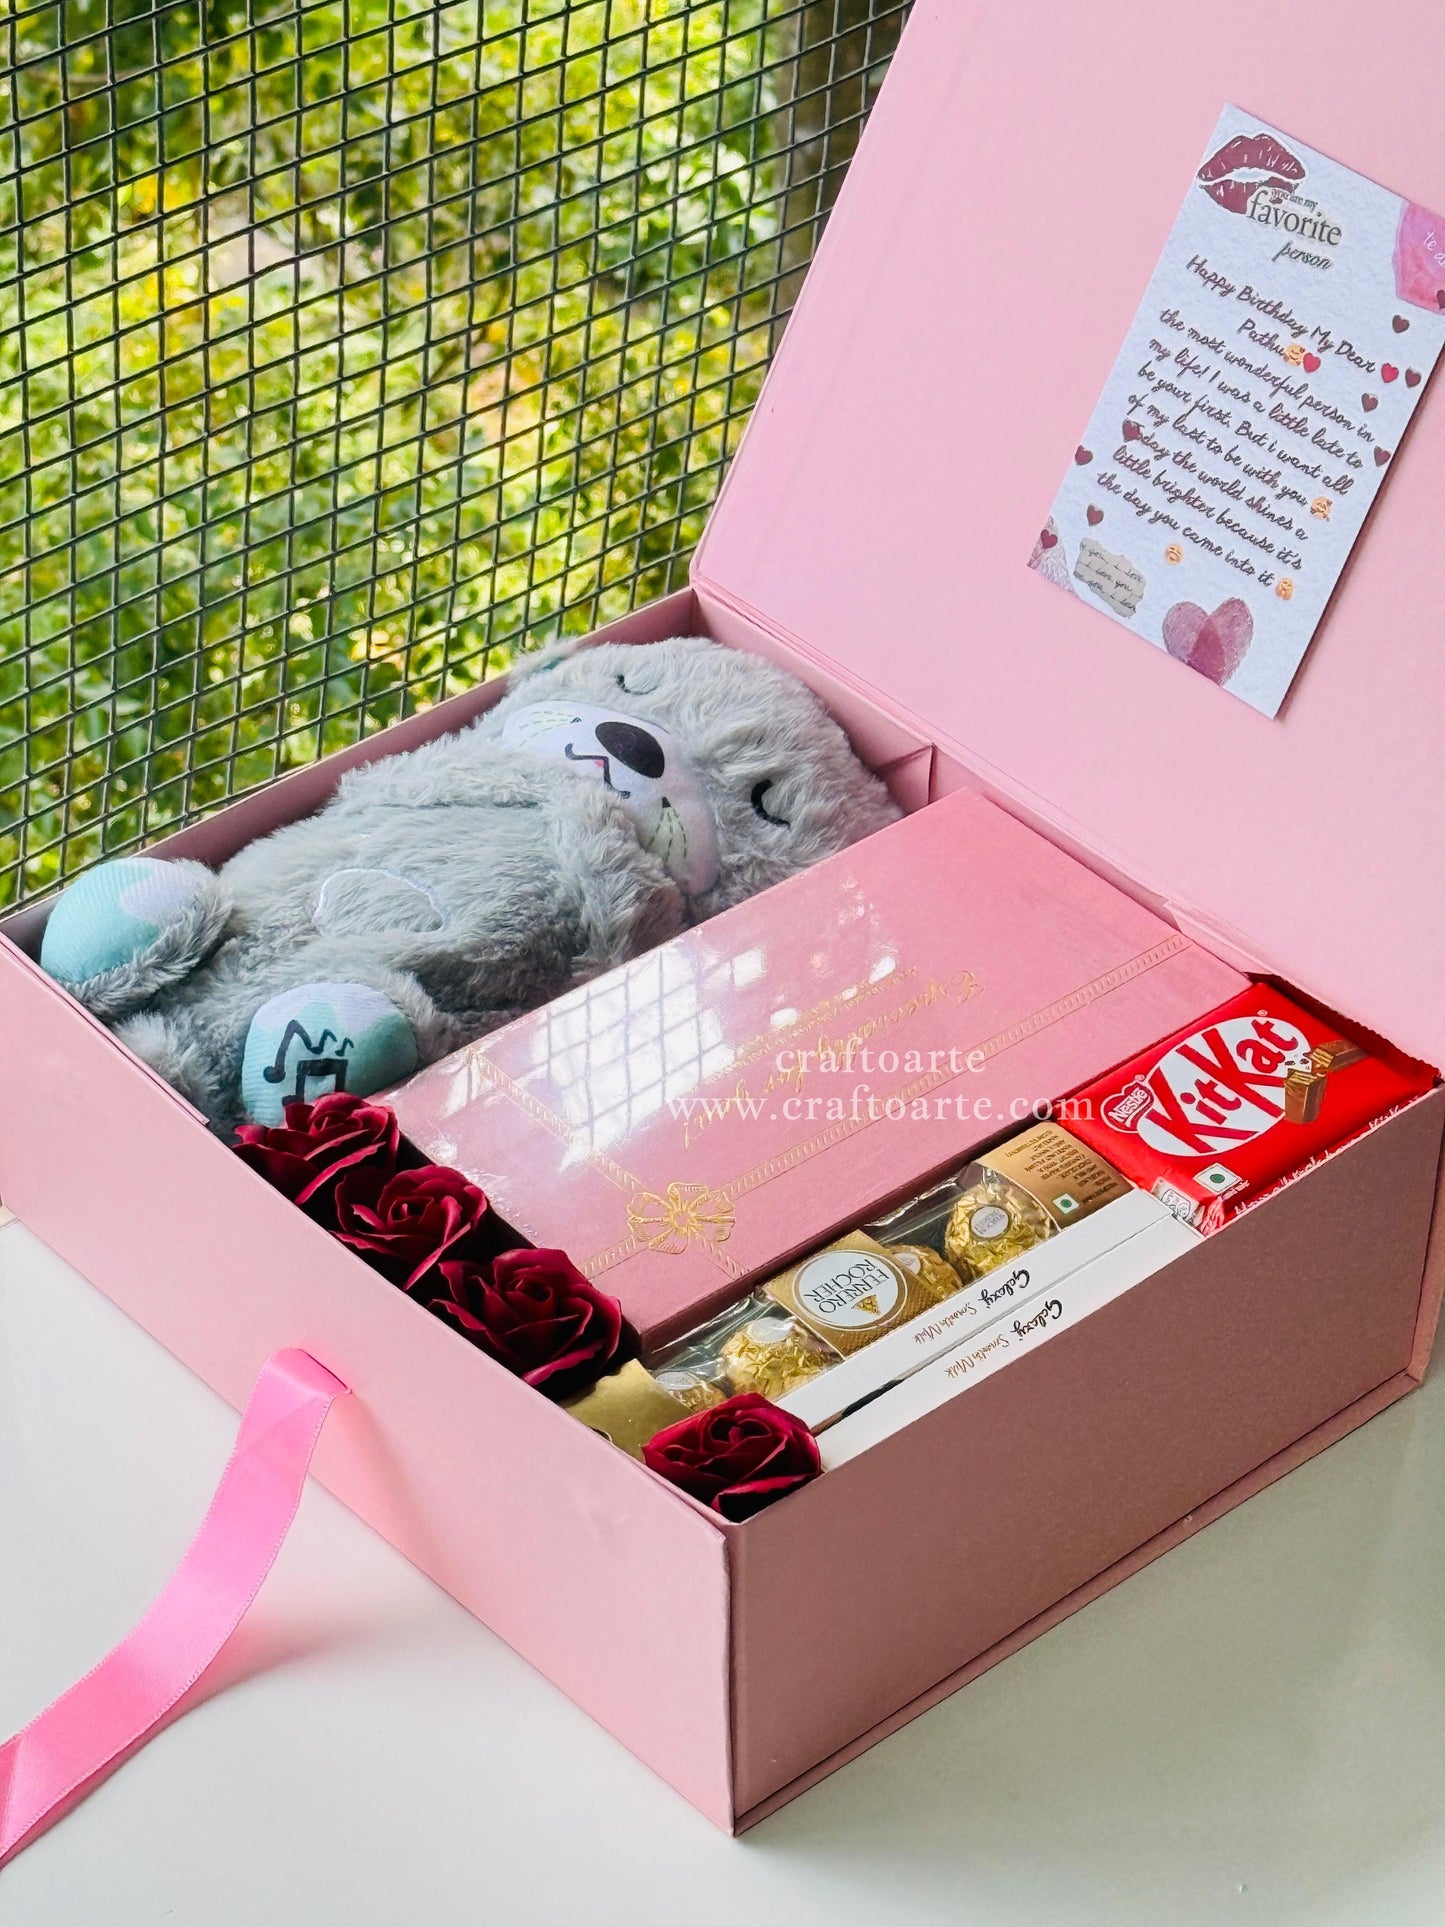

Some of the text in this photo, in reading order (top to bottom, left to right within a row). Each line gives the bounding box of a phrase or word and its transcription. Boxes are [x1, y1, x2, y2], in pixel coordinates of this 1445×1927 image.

[1247, 189, 1342, 246] favorite
[1303, 198, 1318, 213] my
[1271, 240, 1333, 270] person
[1186, 254, 1376, 374] Happy Birthday My Dear
[1149, 338, 1364, 469] my life! I was a little late to
[1159, 308, 1375, 443] the most wonderful person in
[1126, 393, 1309, 508] of my last to be with you
[1137, 359, 1156, 381] be
[1151, 379, 1193, 405] your
[1234, 420, 1269, 448] But
[1276, 449, 1323, 479] want
[1321, 474, 1355, 496] all
[1096, 471, 1276, 588] the day you came into it
[1112, 444, 1302, 571] little brighter because it's
[1172, 450, 1198, 473] the
[1197, 470, 1247, 501] world
[1244, 495, 1294, 531] shines
[1295, 527, 1309, 541] a
[802, 1257, 875, 1301] ROCHER
[818, 1267, 890, 1315] FERRERO
[977, 1268, 1030, 1310] Galaxy
[1010, 1299, 1063, 1342] Galaxy
